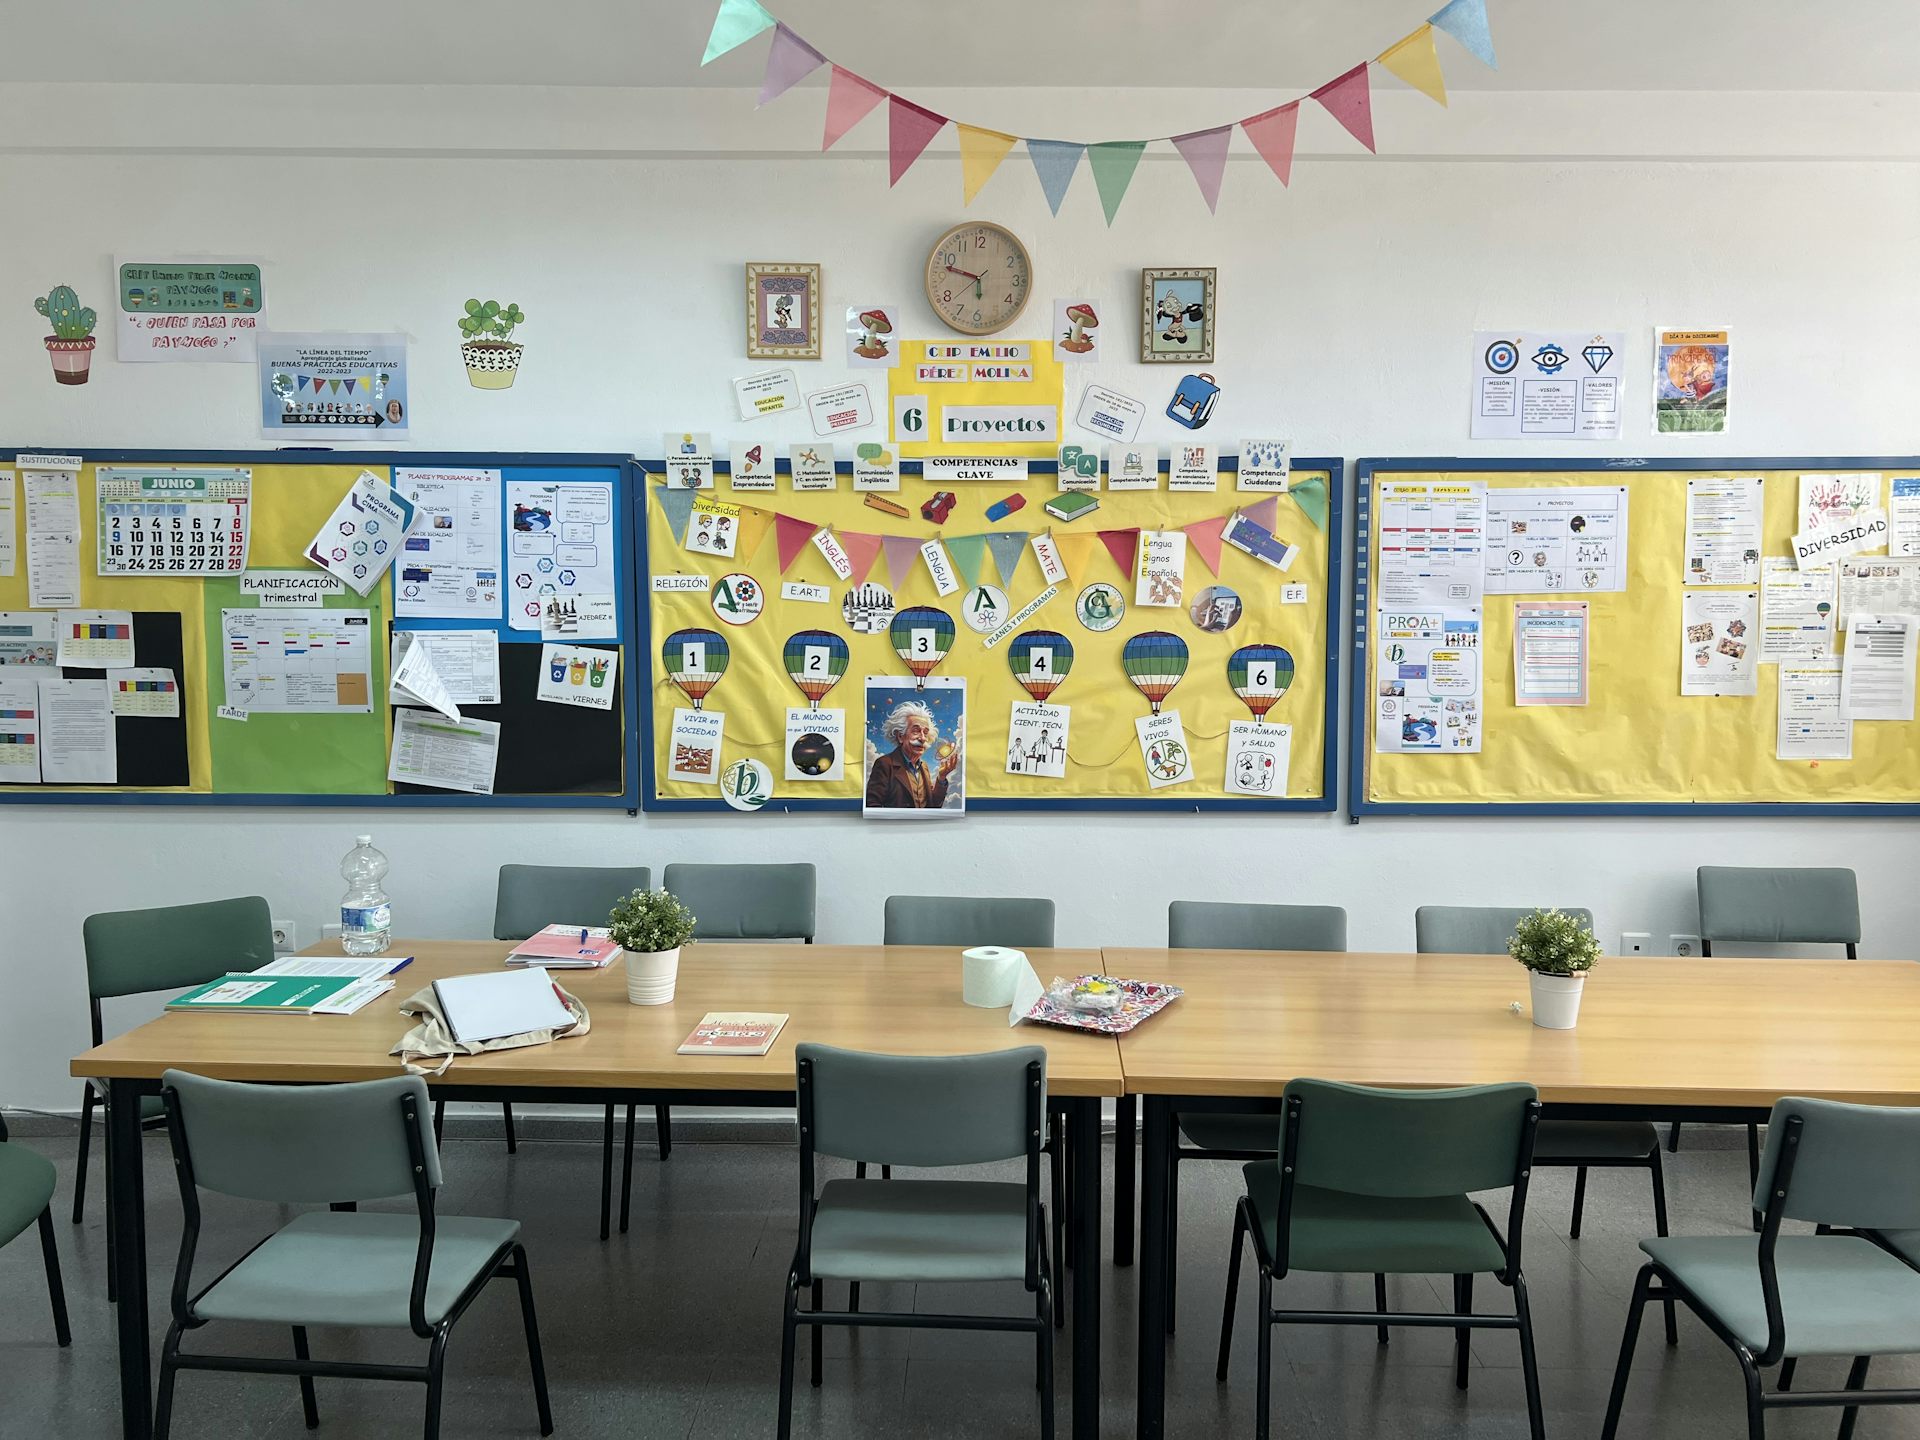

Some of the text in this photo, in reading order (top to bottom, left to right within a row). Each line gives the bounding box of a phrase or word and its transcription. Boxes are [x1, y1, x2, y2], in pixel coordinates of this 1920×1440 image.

[958, 240, 967, 252] 11
[975, 236, 986, 248] 12
[944, 253, 956, 265] 10
[1006, 256, 1014, 268] 2
[1012, 275, 1020, 287] 3
[943, 290, 951, 302] 8
[1004, 293, 1013, 304] 4
[956, 304, 965, 316] 7
[972, 310, 982, 322] 6
[192, 316, 226, 329] PASA
[231, 316, 256, 328] POR
[929, 347, 1019, 358] CEIP EMILIO
[349, 361, 398, 369] EDUCATIVAS
[919, 366, 1029, 379] PÉREZ MOLINA
[754, 395, 785, 407] EDUCACIÓN
[902, 408, 923, 432] 6
[948, 417, 1046, 437] Proyectos
[21, 456, 81, 465] SUSTITUCIONES
[932, 458, 1019, 467] COMPETENCIAS
[957, 471, 994, 479] CLAVE
[1241, 469, 1286, 477] Competencia
[151, 479, 196, 489] JUNIO
[1244, 478, 1282, 486] Ciudadana
[234, 504, 240, 516] 1
[362, 500, 378, 514] CIMA
[365, 493, 399, 520] PROGRAMA
[691, 500, 741, 517] Diversidad
[112, 517, 241, 529] 2 3 4 5 6 7 8
[112, 531, 243, 543] 9 10 11 12 13 14 15
[1799, 520, 1887, 558] DIVERSIDAD
[109, 544, 243, 556] 16 17 18 19 20 21 22
[1143, 540, 1173, 550] Lengua
[817, 533, 850, 574] INGLÉS
[1037, 543, 1058, 576] MATE
[1143, 554, 1170, 564] Signos
[128, 558, 145, 570] 24
[148, 558, 165, 570] 25
[169, 558, 185, 570] 26
[189, 558, 205, 570] 27
[208, 558, 224, 570] 28
[228, 558, 241, 570] 29
[924, 545, 949, 590] LENGUA
[1141, 567, 1178, 578] Española
[244, 575, 339, 589] PLANIFICACIÓN
[656, 577, 708, 589] RELIGIÓN
[264, 592, 317, 602] trimestral
[790, 585, 822, 599] E.ART.
[1286, 590, 1305, 600] E.F.
[988, 623, 1013, 645] PLANES
[1016, 587, 1057, 622] PROGRAMAS
[1388, 616, 1439, 629] PROA+
[917, 637, 928, 653] 3
[689, 651, 697, 667] 1
[810, 655, 821, 670] 2
[1034, 656, 1046, 672] 4
[1256, 669, 1268, 685] 6
[572, 695, 608, 706] VIERNES
[221, 707, 247, 719] TARDE
[791, 713, 833, 721] EL MUNDO
[1015, 707, 1060, 717] ACTIVIDAD
[684, 714, 708, 724] VIVIR
[1148, 716, 1173, 728] SERES
[676, 726, 718, 737] SOCIEDAD
[1144, 730, 1169, 741] VIVOS
[1233, 726, 1287, 737] SER HUMANO
[1249, 739, 1276, 748] SALUD
